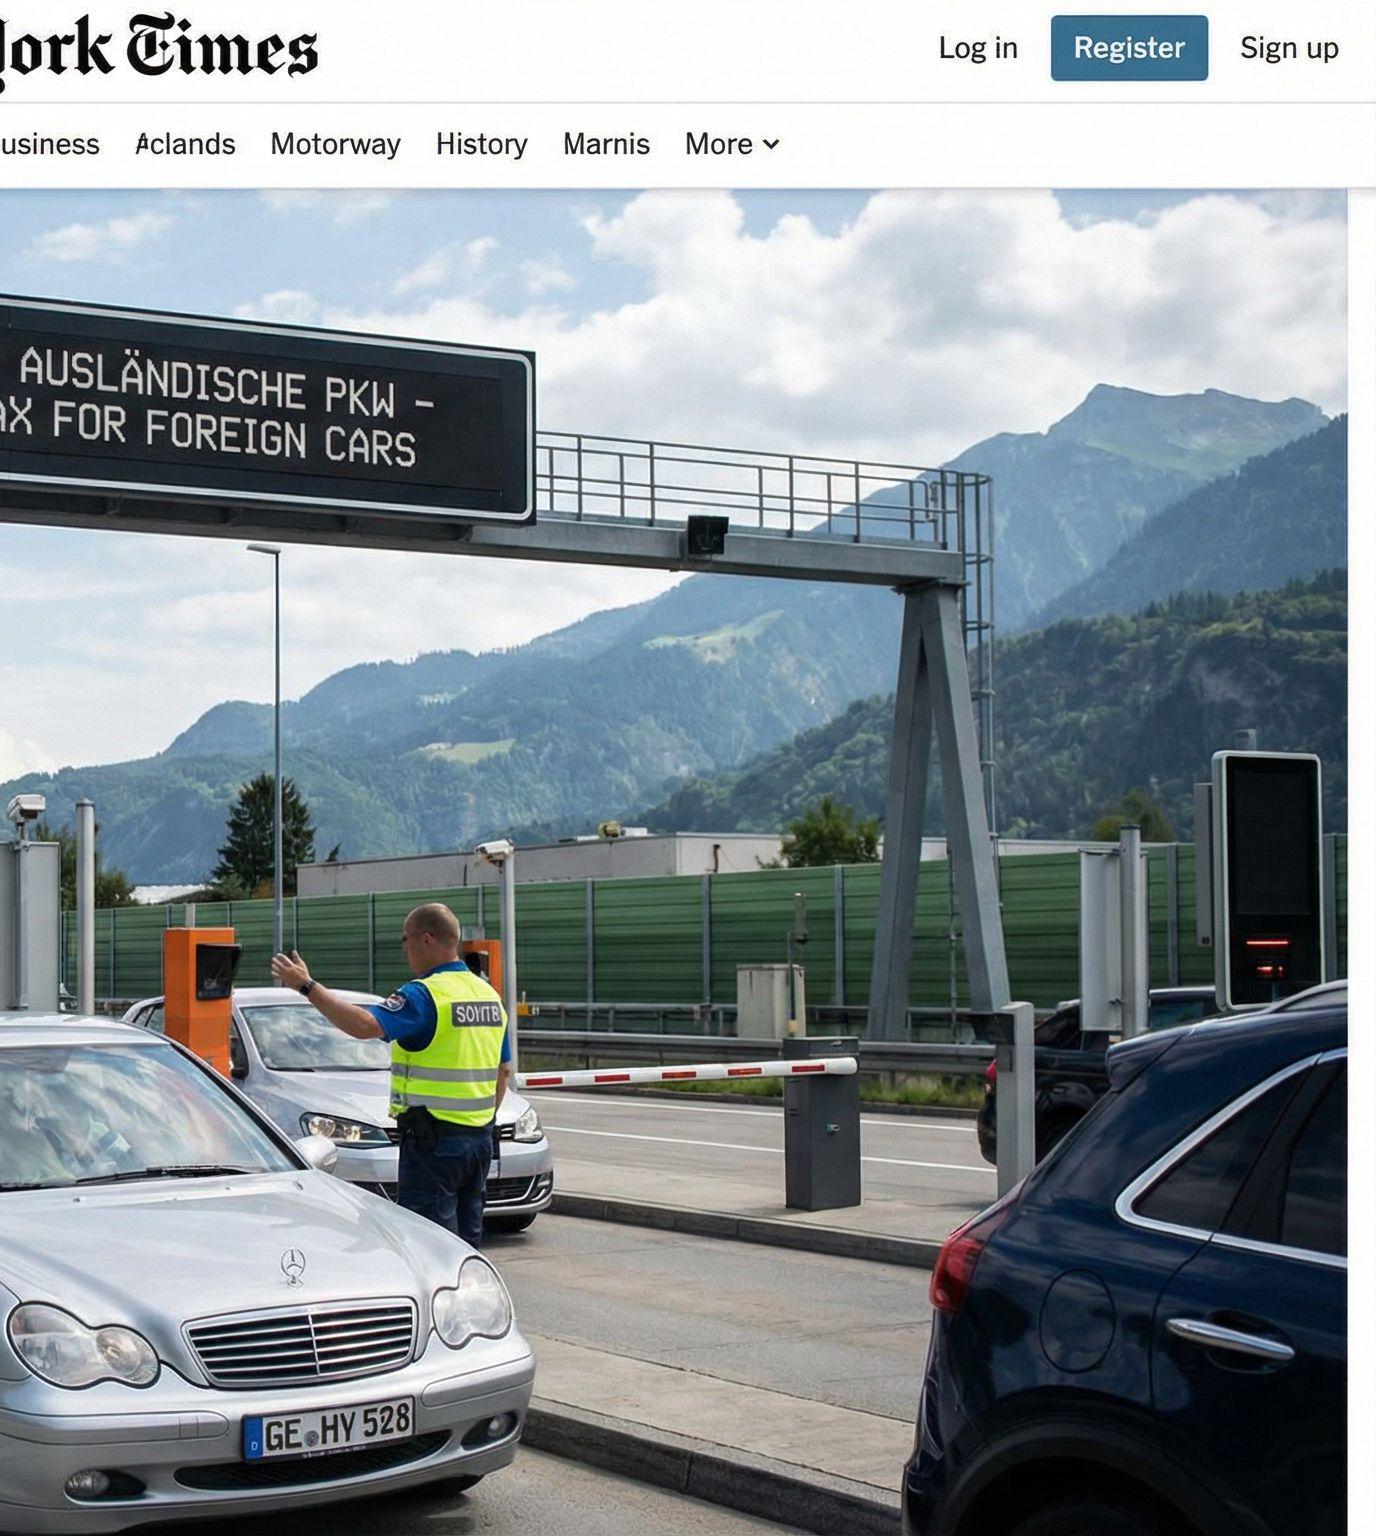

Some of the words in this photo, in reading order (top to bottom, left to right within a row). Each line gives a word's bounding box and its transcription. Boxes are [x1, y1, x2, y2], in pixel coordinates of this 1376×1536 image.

[20, 346, 306, 410] AUSLÄNDISCHE
[326, 376, 394, 418] PKW
[53, 400, 126, 443] FOR
[147, 409, 306, 459] FOREIGN
[325, 425, 416, 468] CARS
[251, 1441, 258, 1451] D
[265, 1418, 303, 1452] GE
[321, 1411, 356, 1445] HY
[363, 1402, 411, 1438] 528
